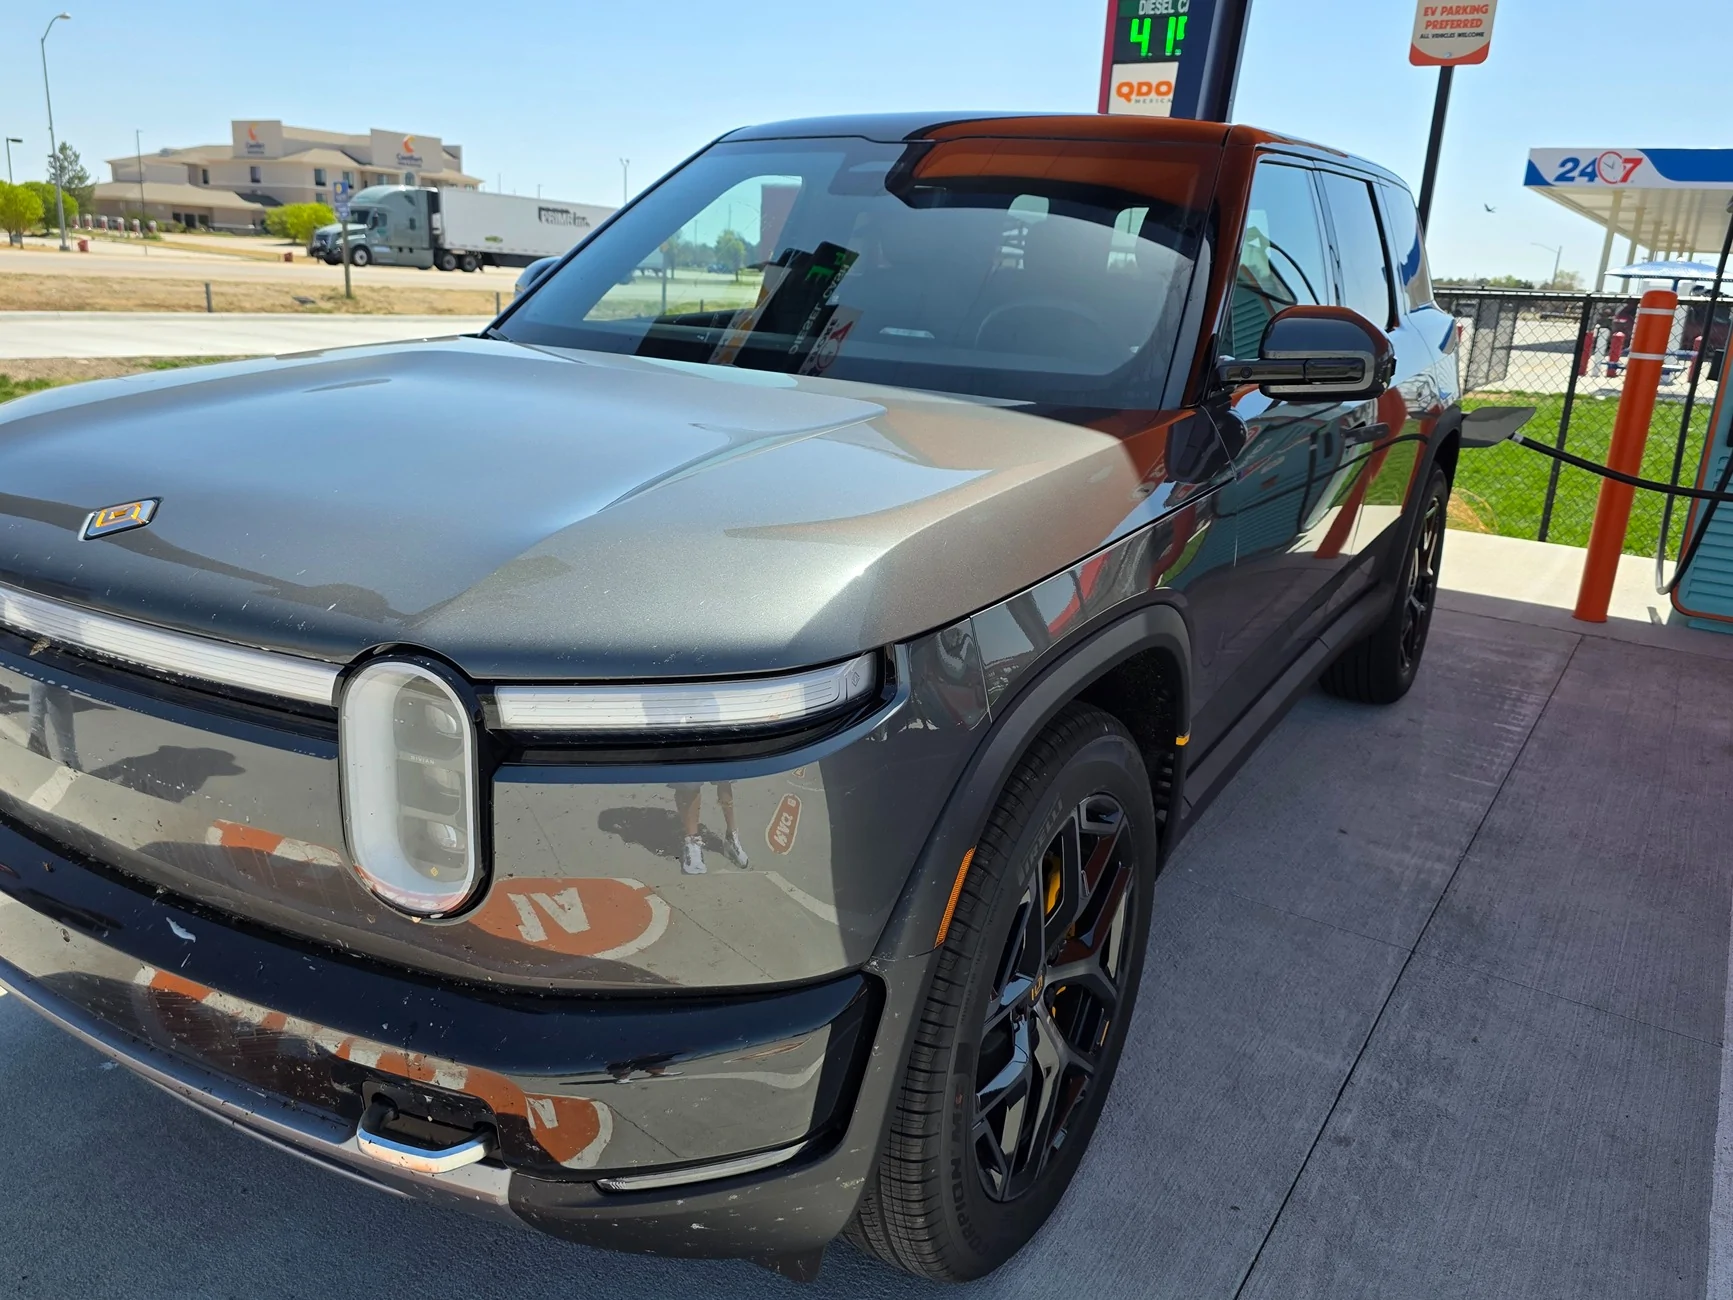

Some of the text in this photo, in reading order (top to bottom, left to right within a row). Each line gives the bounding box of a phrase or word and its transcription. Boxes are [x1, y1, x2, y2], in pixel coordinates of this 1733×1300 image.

[1138, 0, 1190, 15] DIESEL C
[1424, 4, 1489, 17] EV PARKING
[1425, 18, 1483, 30] PREFERRED
[410, 755, 435, 765] RIVIAN
